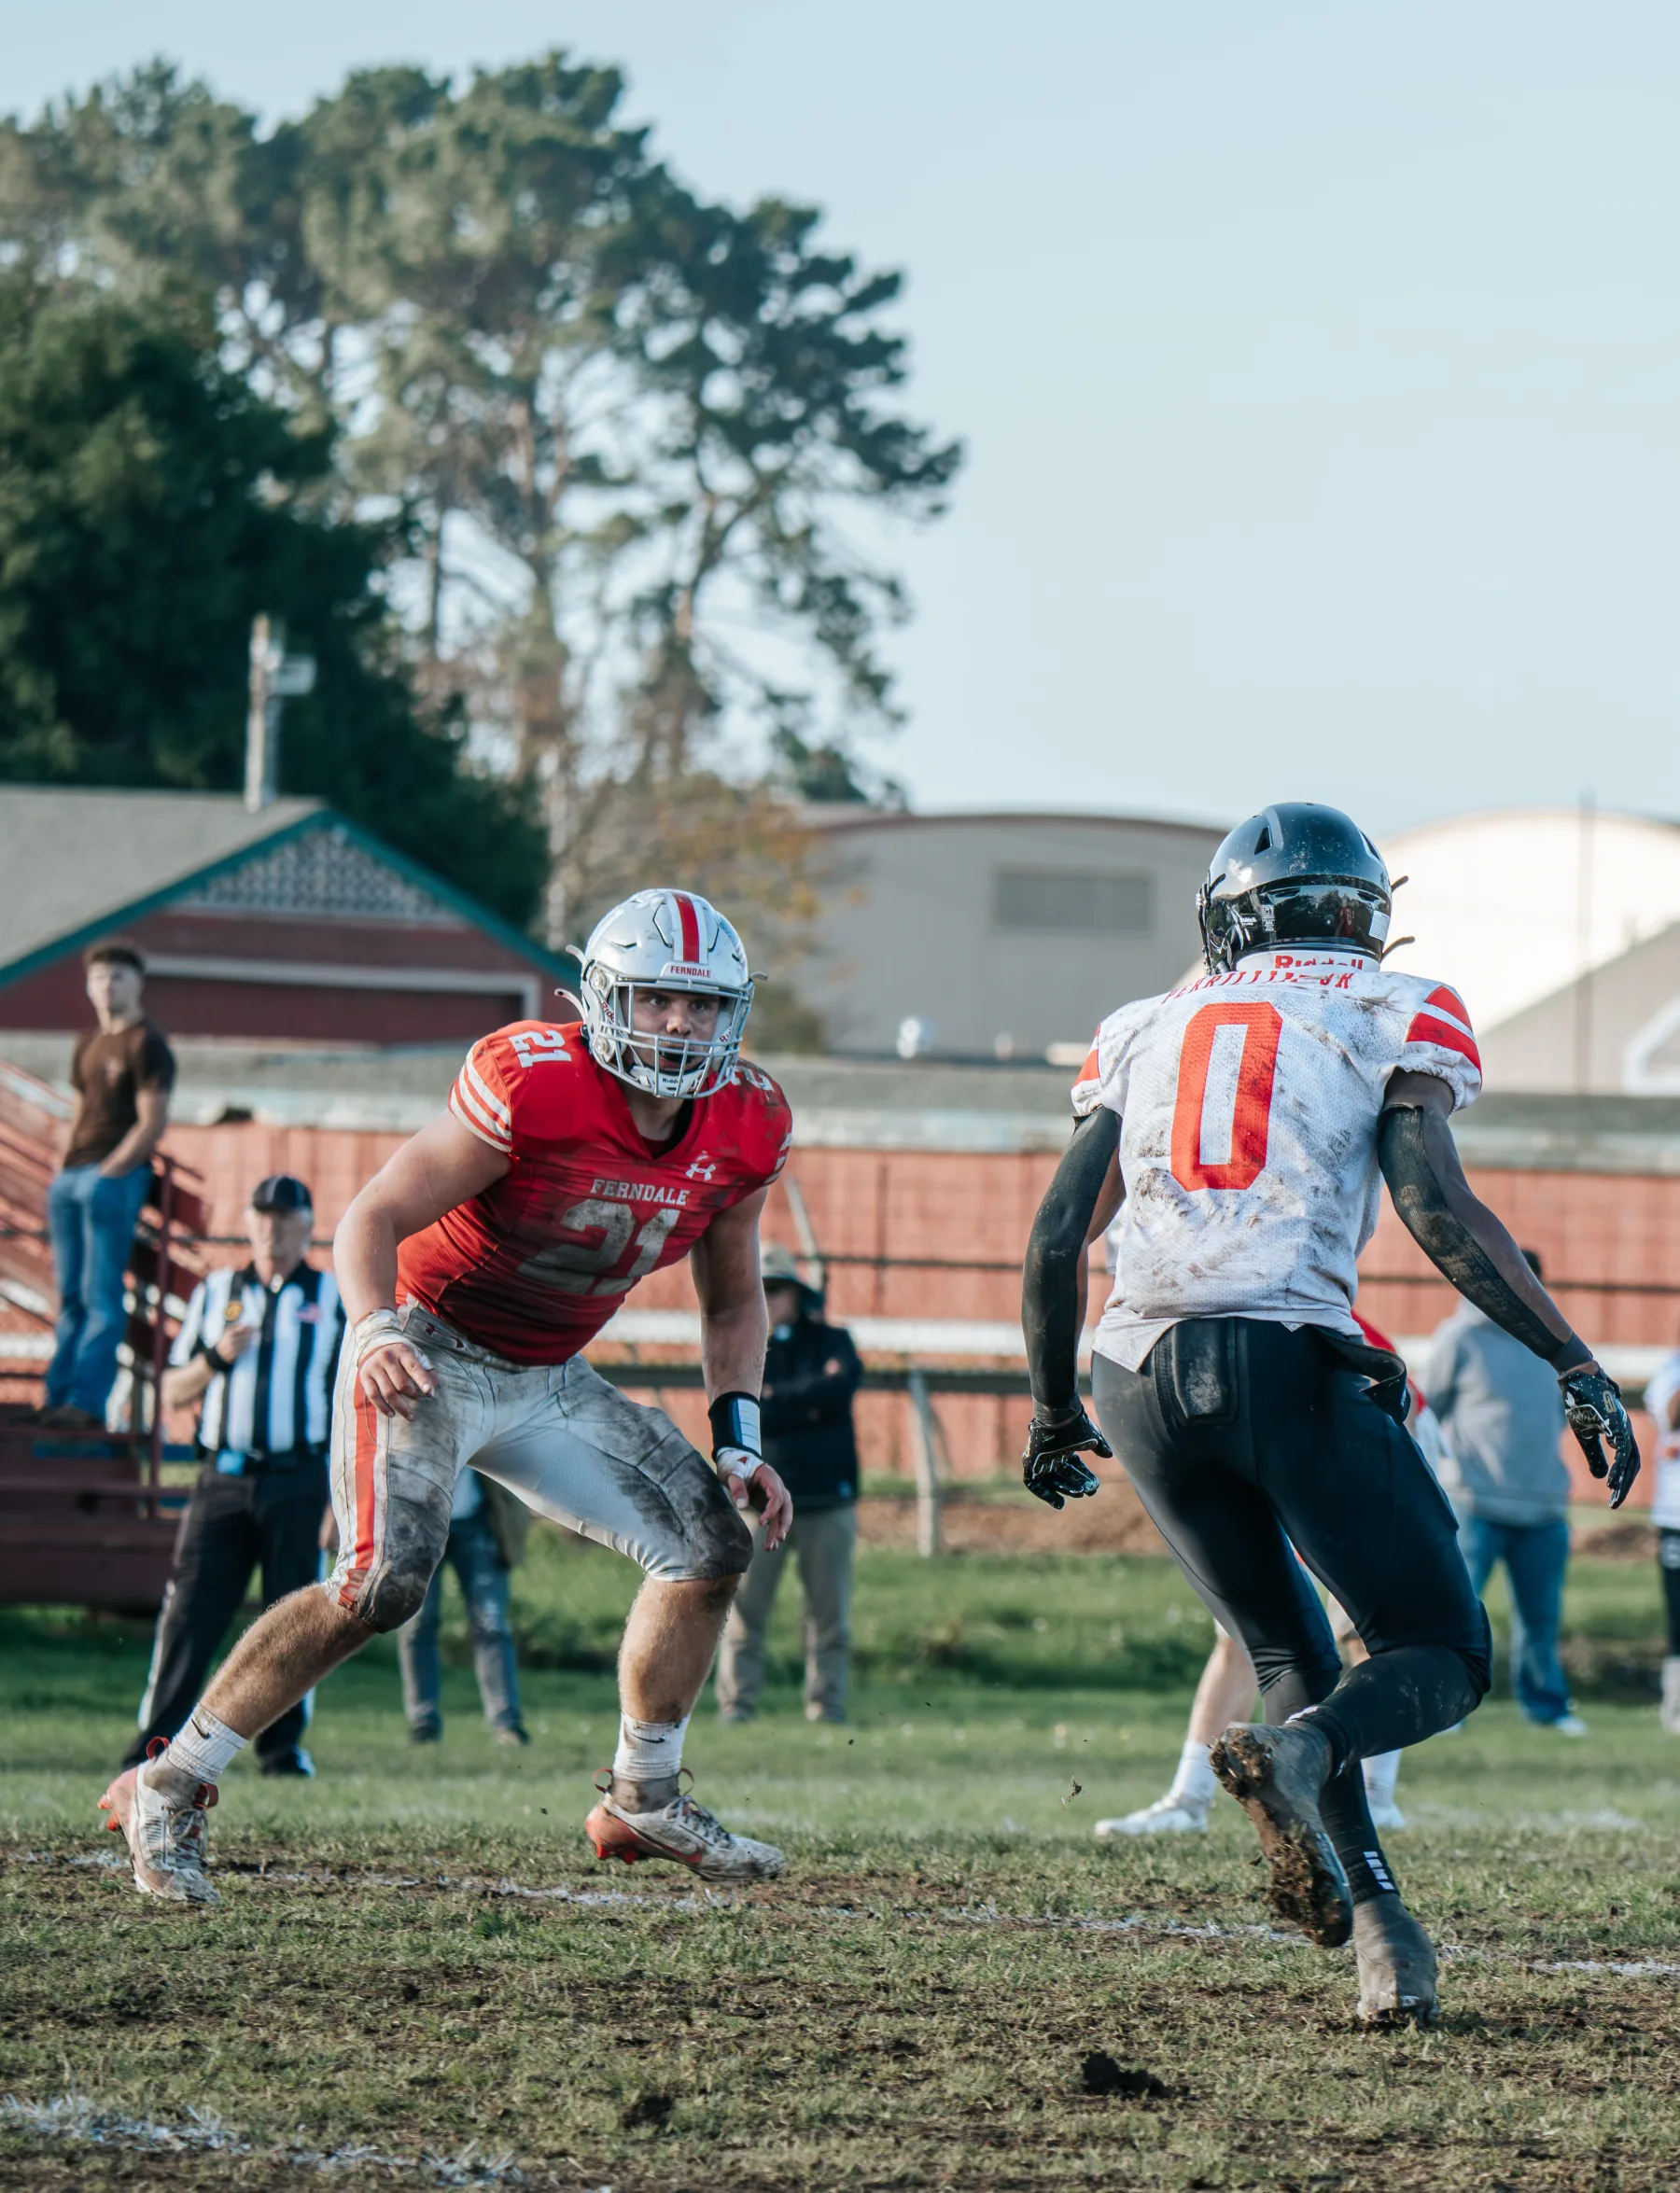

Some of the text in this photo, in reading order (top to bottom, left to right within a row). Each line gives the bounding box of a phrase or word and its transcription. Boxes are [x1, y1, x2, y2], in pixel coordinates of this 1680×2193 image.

[670, 965, 711, 978] FERNDALE
[508, 1029, 572, 1068] 21
[1170, 1001, 1283, 1192] 0
[590, 1179, 691, 1206] FERNDALE
[517, 1198, 680, 1295] 21
